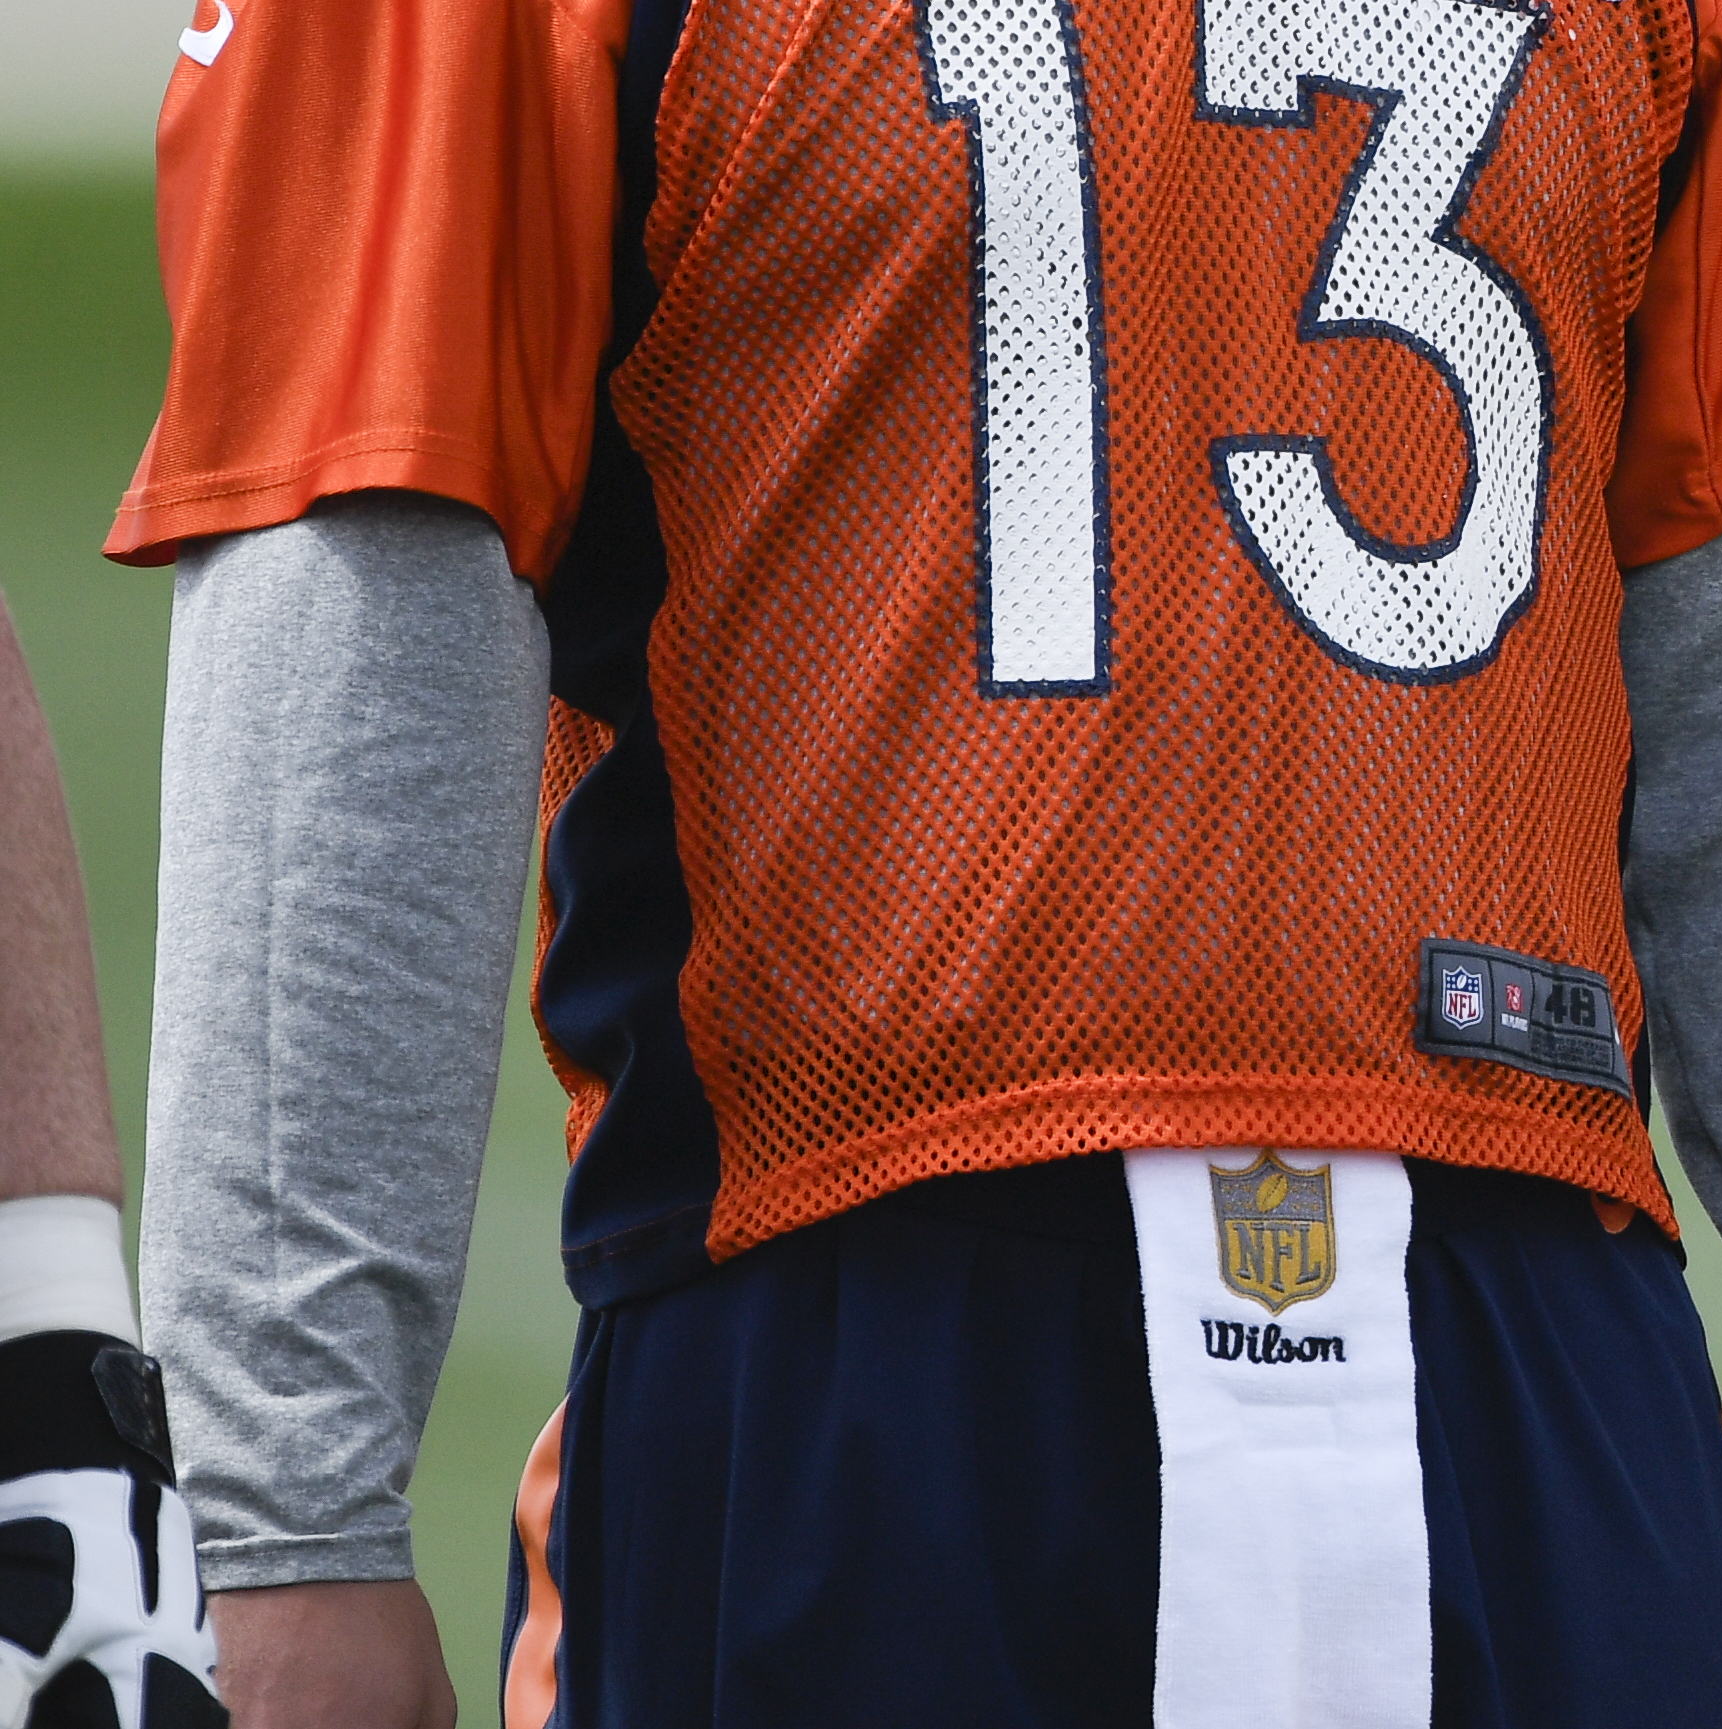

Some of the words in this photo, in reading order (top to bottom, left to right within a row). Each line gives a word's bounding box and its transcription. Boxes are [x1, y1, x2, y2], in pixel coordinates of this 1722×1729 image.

[1447, 992, 1477, 1020] NFL
[1545, 983, 1597, 1028] 48
[1232, 1222, 1322, 1293] NFL
[1200, 1319, 1347, 1364] Wilson
